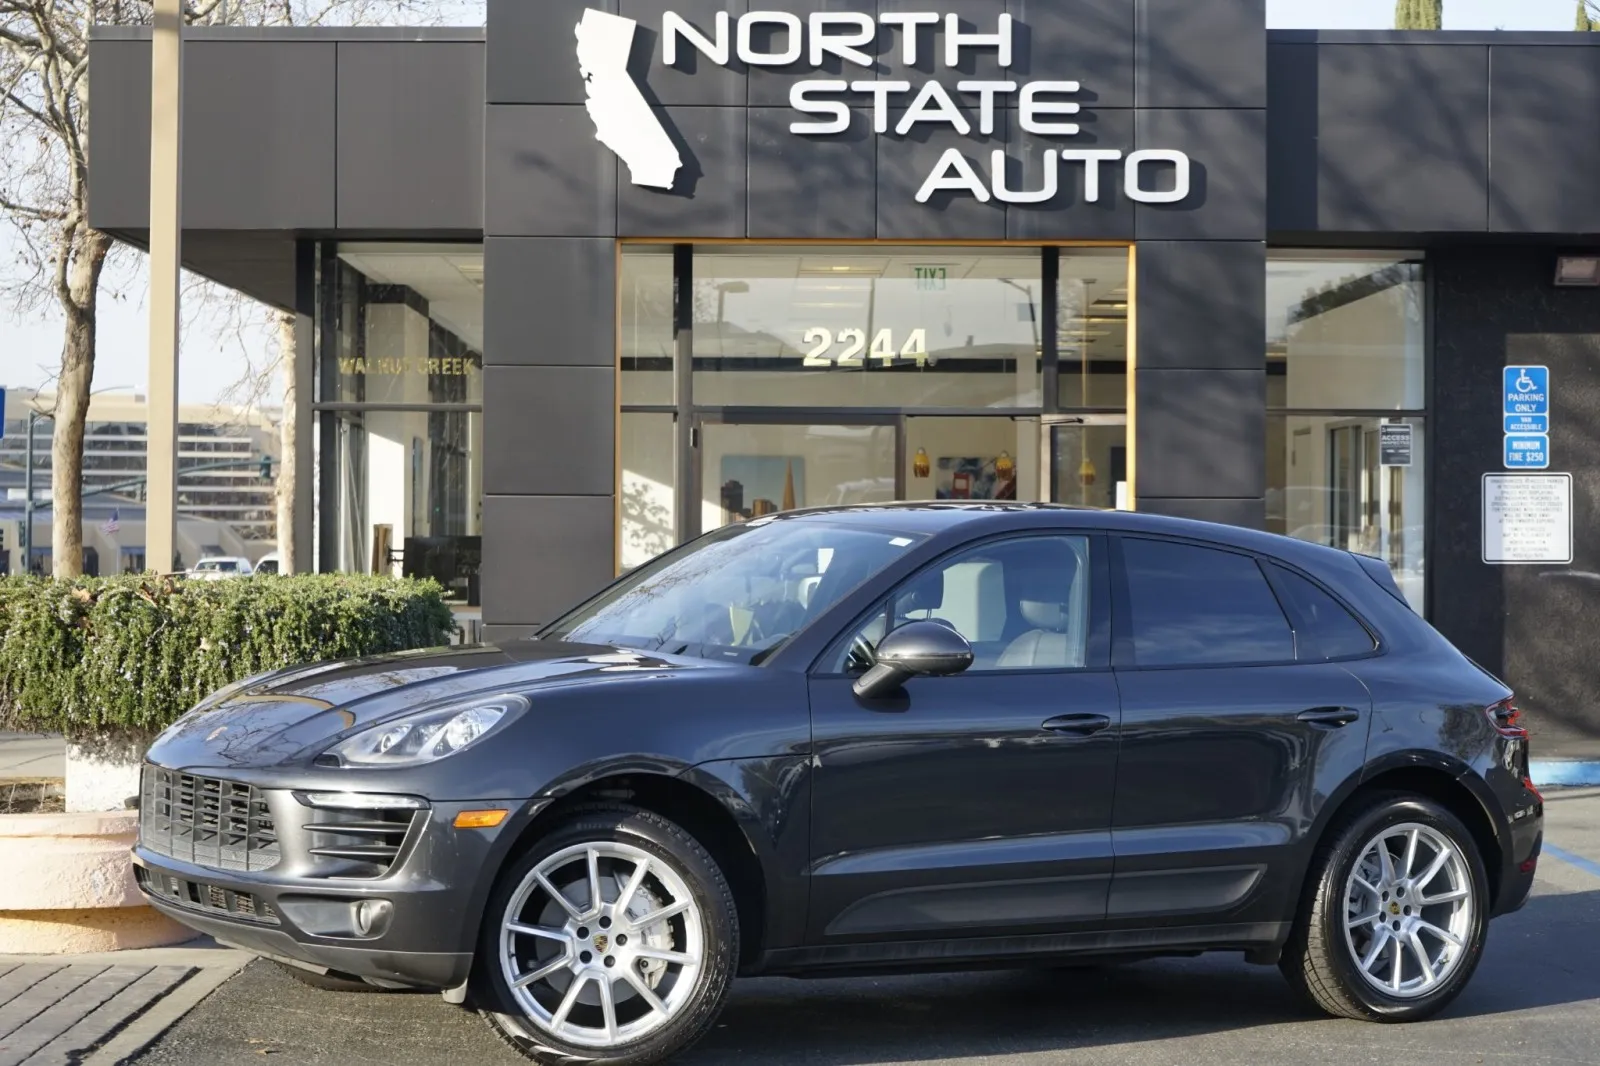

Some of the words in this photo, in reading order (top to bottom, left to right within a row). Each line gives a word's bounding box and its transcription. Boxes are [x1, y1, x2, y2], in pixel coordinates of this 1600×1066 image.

[661, 10, 1013, 68] NORTH
[788, 80, 1081, 136] STATE
[914, 147, 1191, 204] AUTO
[802, 326, 929, 368] 2244
[416, 357, 475, 375] CREEK
[1507, 392, 1545, 403] PARKING
[1514, 403, 1537, 413] ONLY
[1512, 440, 1541, 450] MINIMUM
[1508, 451, 1524, 462] FINE
[1525, 451, 1544, 463] $250
